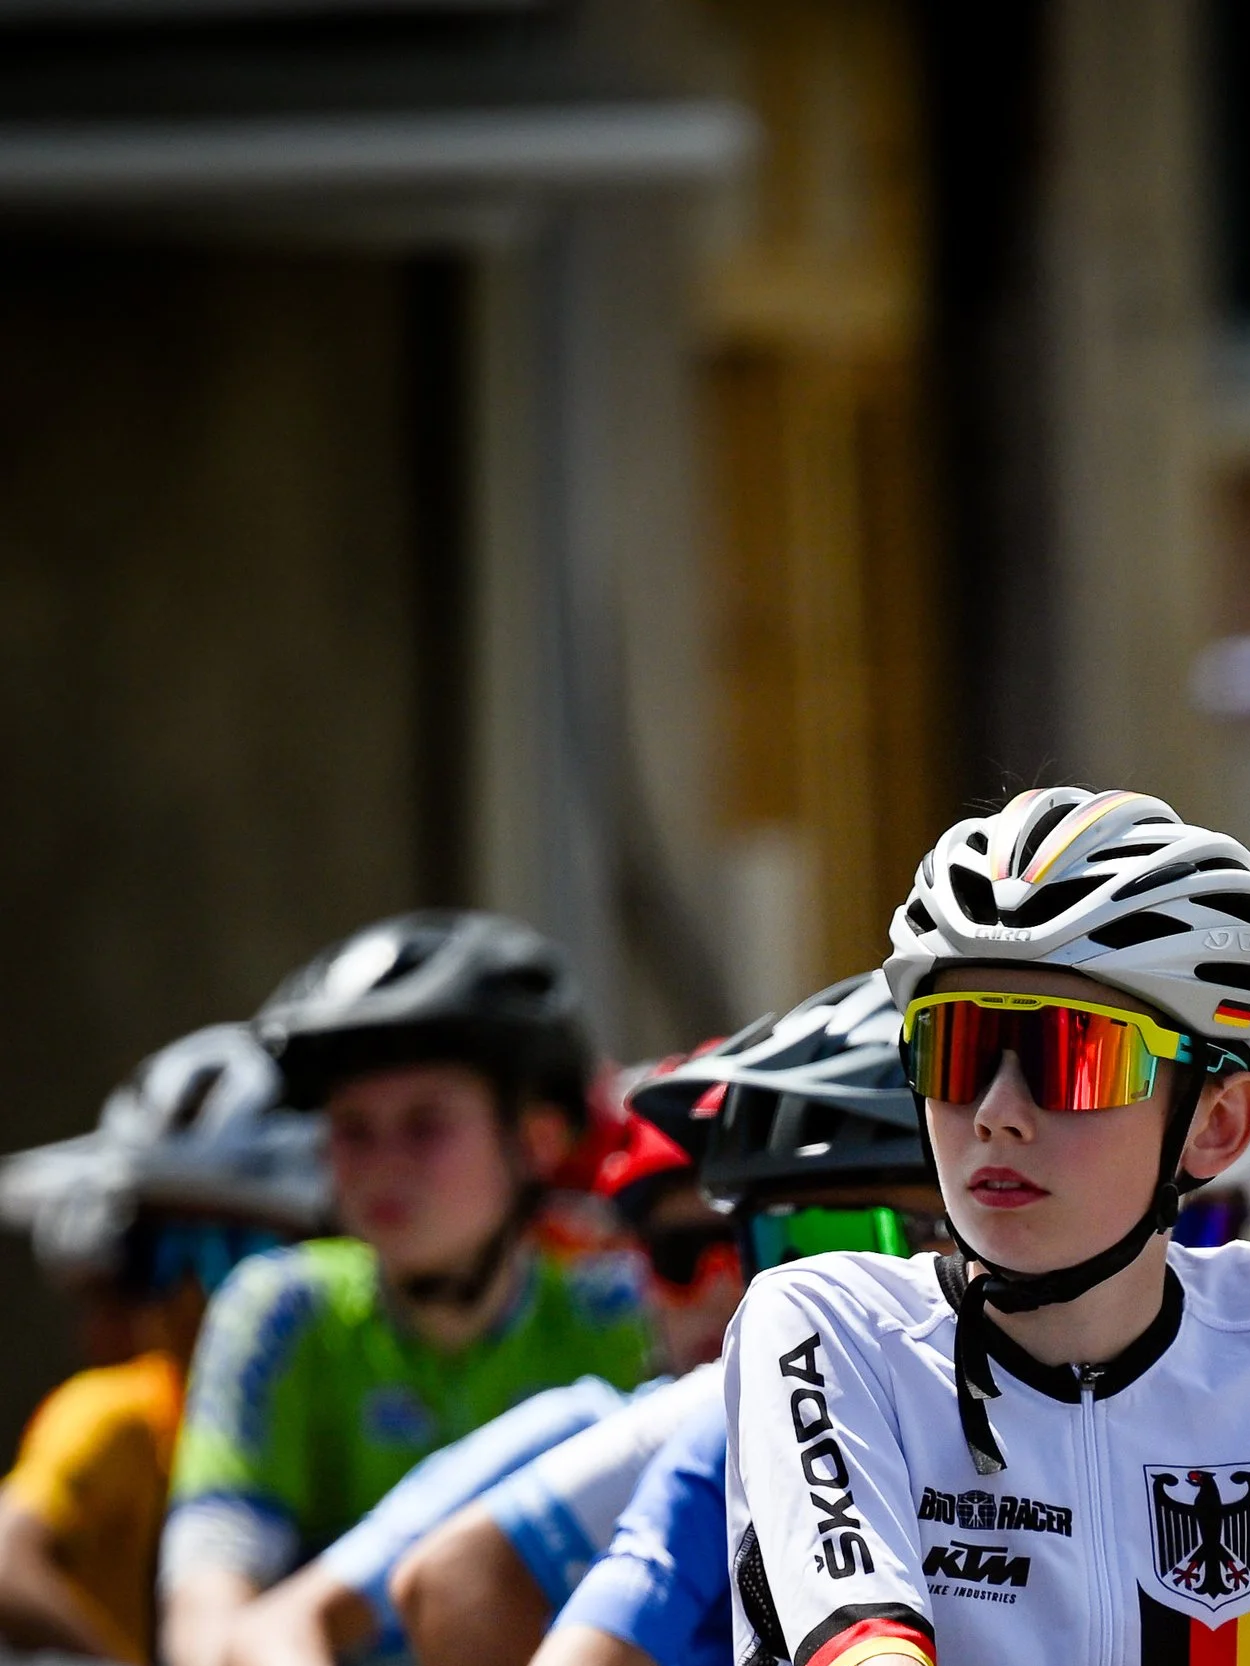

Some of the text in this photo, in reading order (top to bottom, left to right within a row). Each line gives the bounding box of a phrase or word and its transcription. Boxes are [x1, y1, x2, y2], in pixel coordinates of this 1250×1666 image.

[975, 927, 1031, 942] GIRO
[778, 1331, 875, 1580] ŠKODA
[921, 1540, 1031, 1588] KTM
[953, 1585, 1017, 1605] INDUSTRIES
